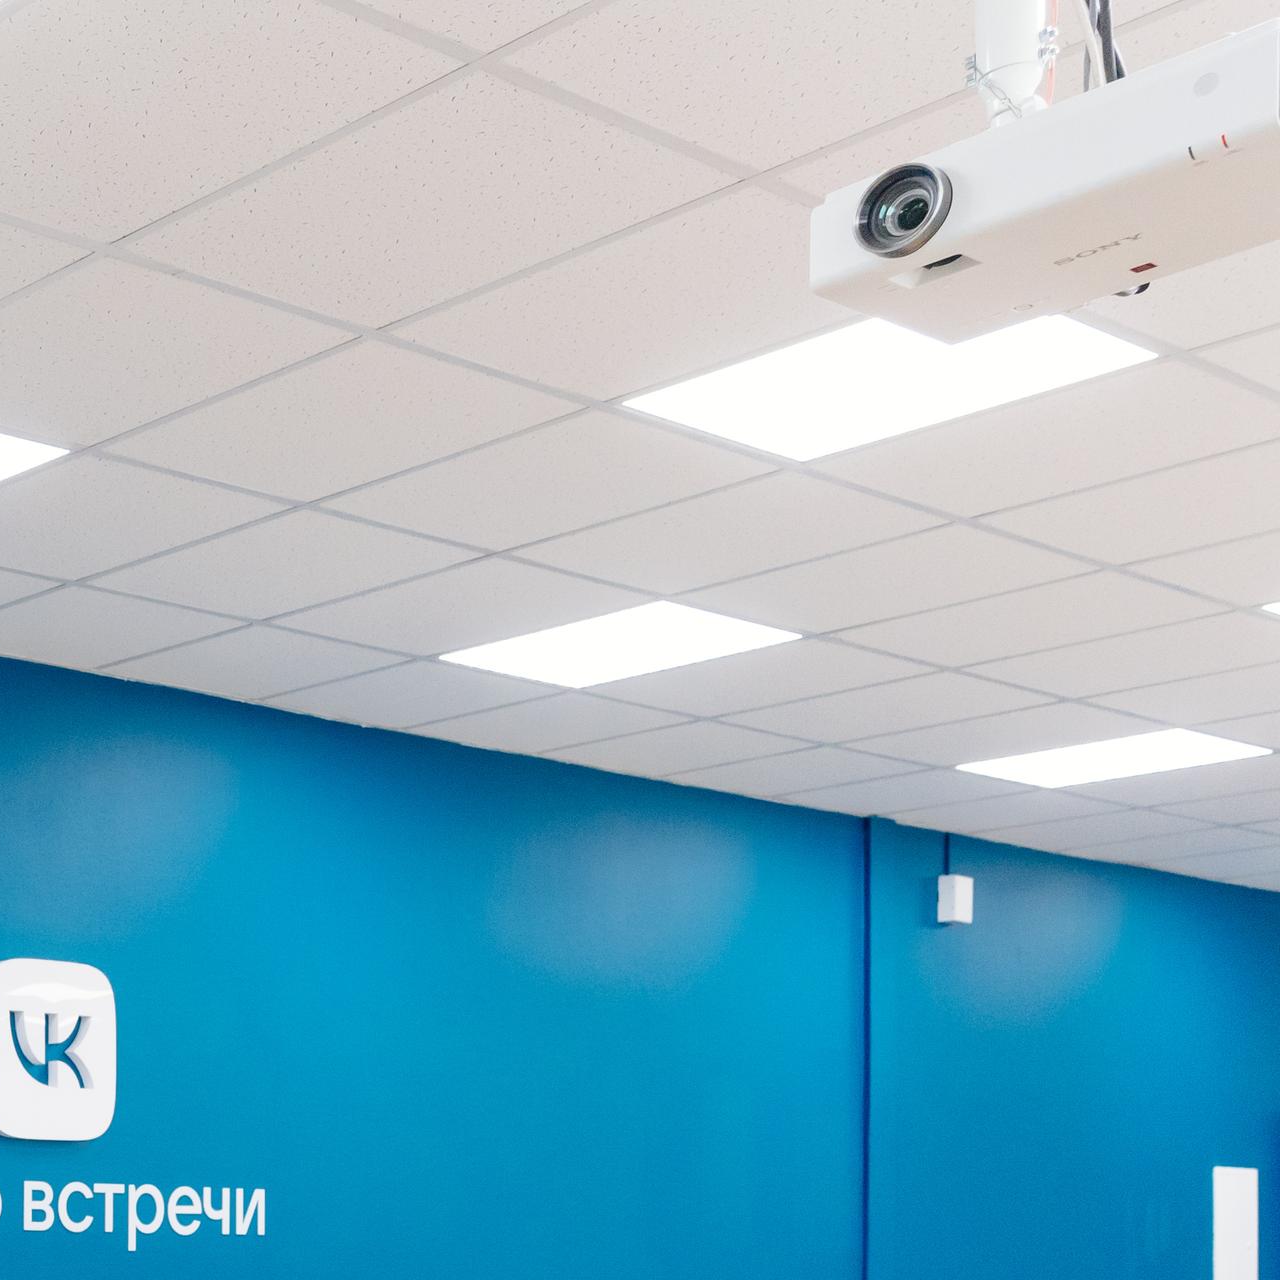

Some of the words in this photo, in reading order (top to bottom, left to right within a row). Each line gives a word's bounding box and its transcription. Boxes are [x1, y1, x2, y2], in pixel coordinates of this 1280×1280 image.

[1053, 232, 1143, 266] SONY
[9, 1009, 95, 1090] VK
[22, 1179, 266, 1253] встречи
